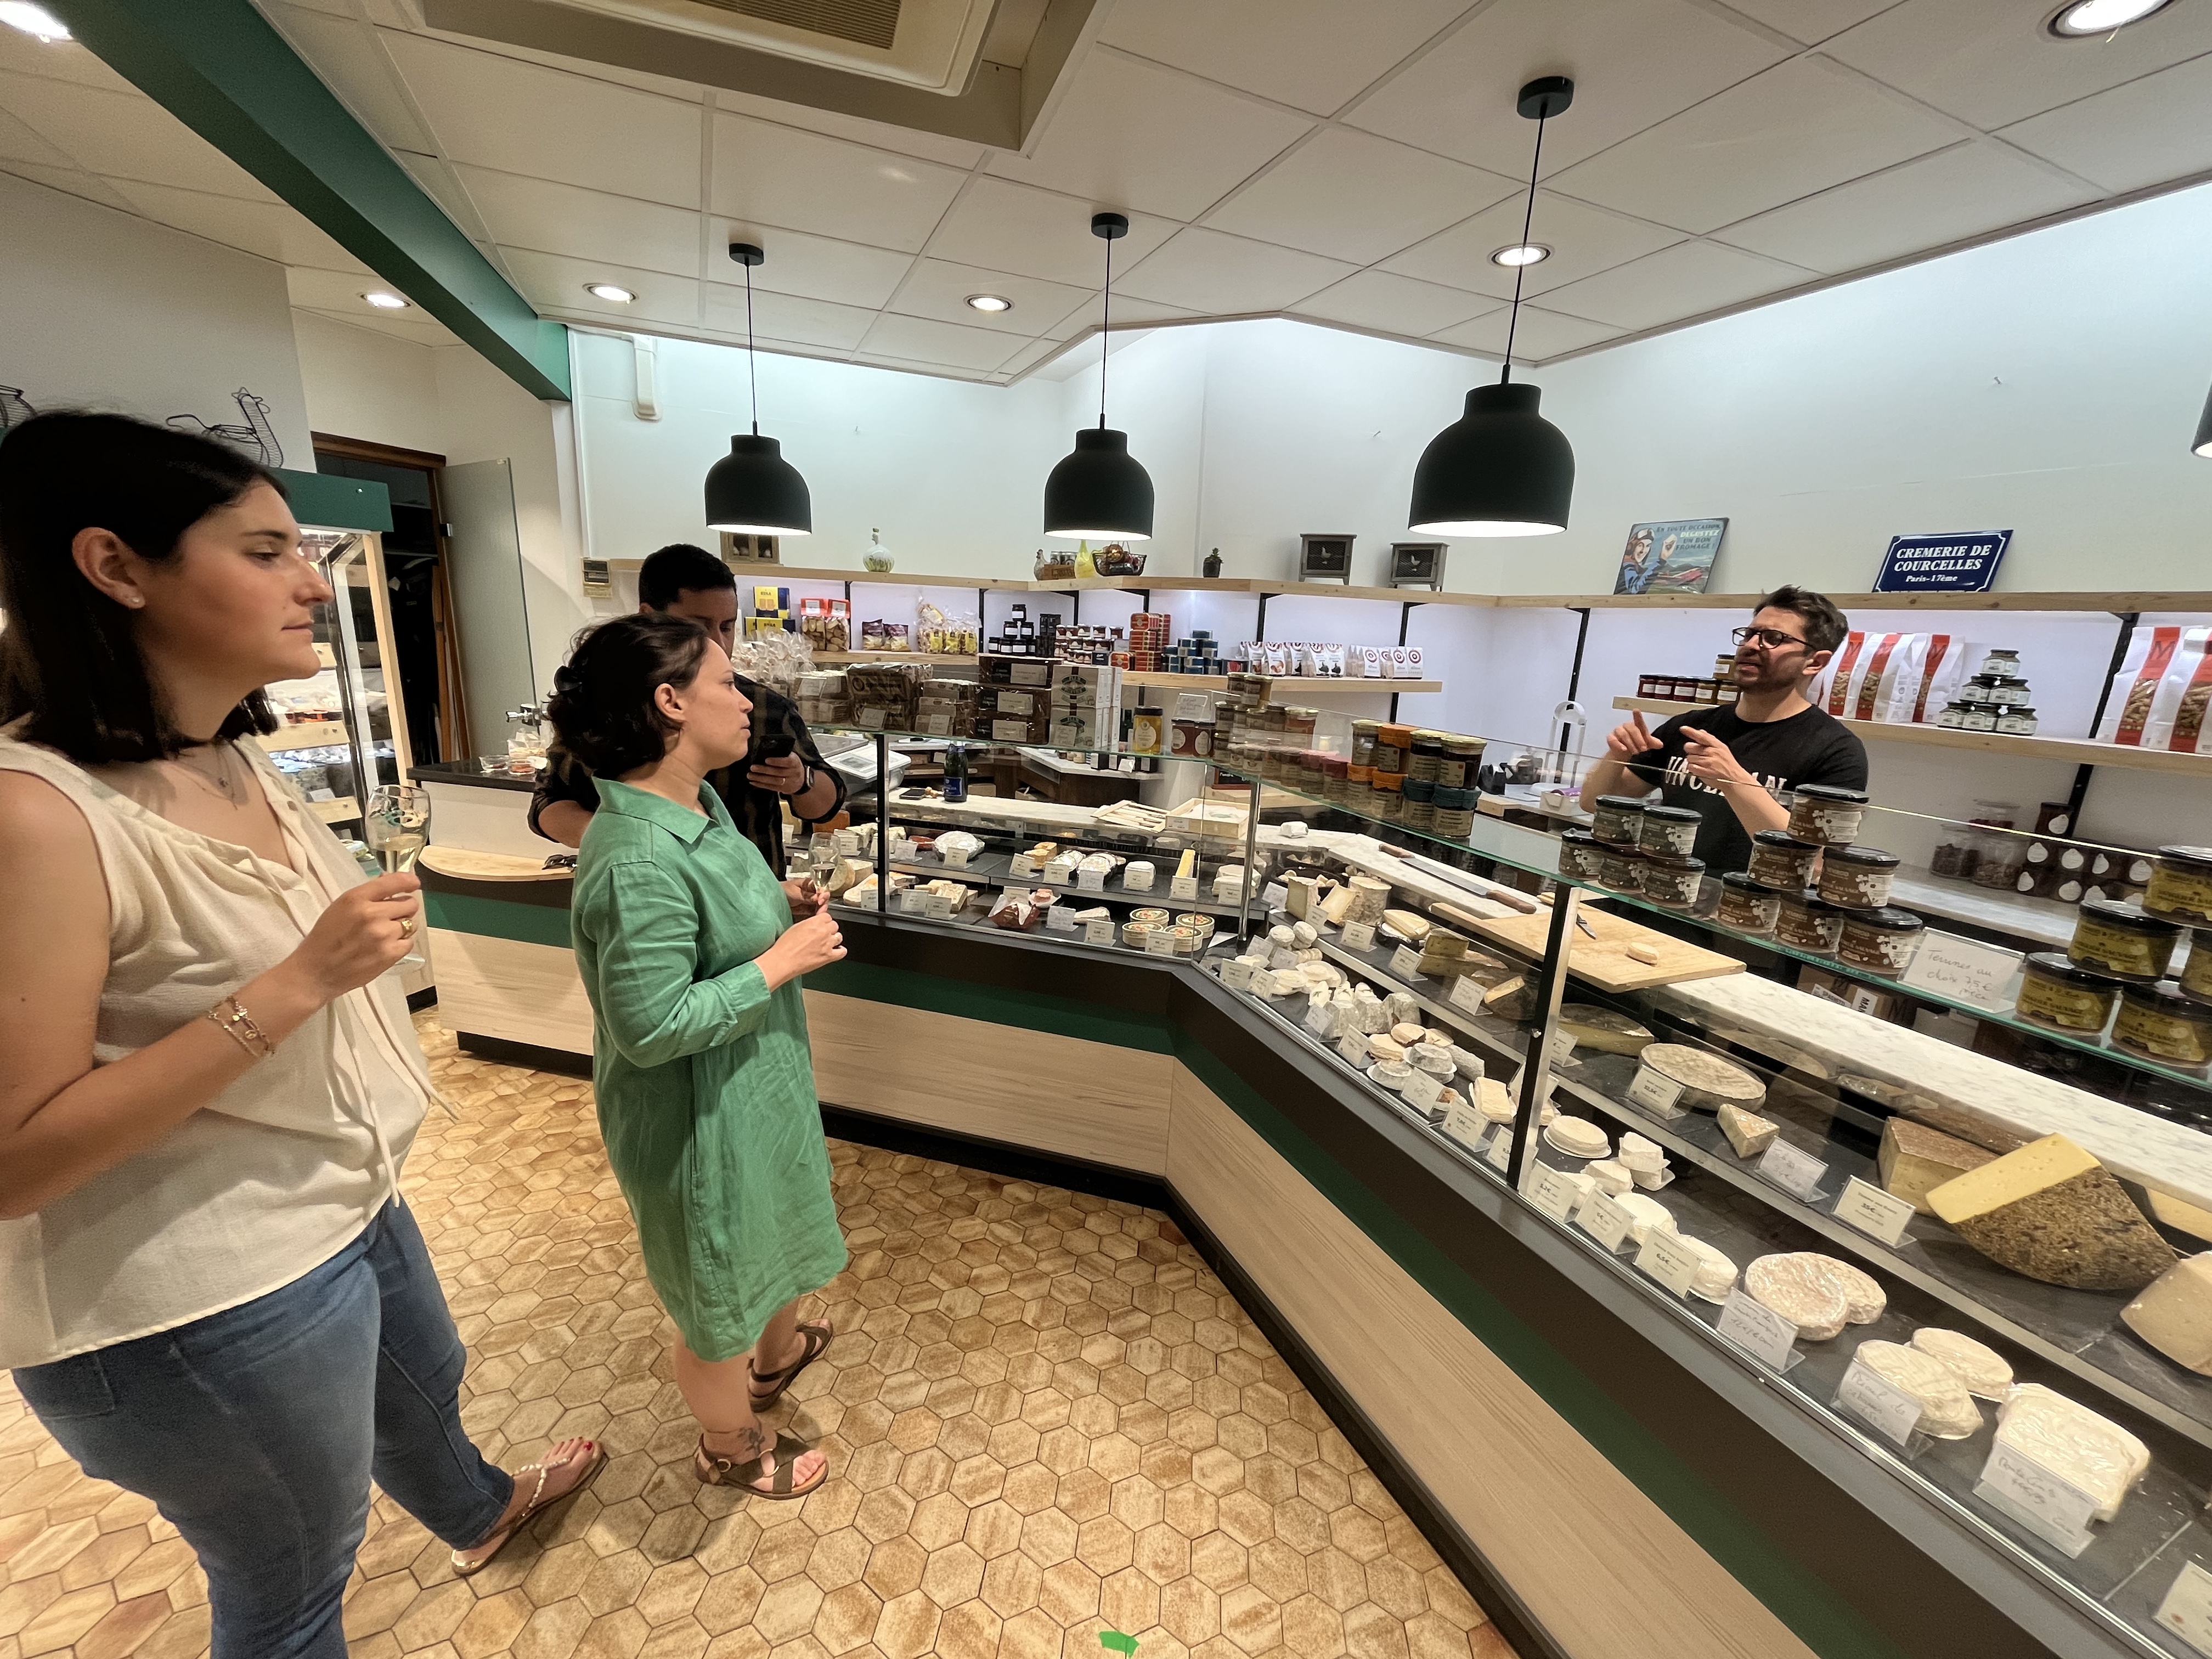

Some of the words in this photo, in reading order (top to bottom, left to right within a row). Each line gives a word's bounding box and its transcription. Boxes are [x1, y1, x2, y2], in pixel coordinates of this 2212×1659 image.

[1896, 546, 1967, 559] CREMERIE
[1971, 545, 1993, 556] DE
[1893, 559, 1983, 572] COURCELLES
[1977, 968, 1992, 978] au
